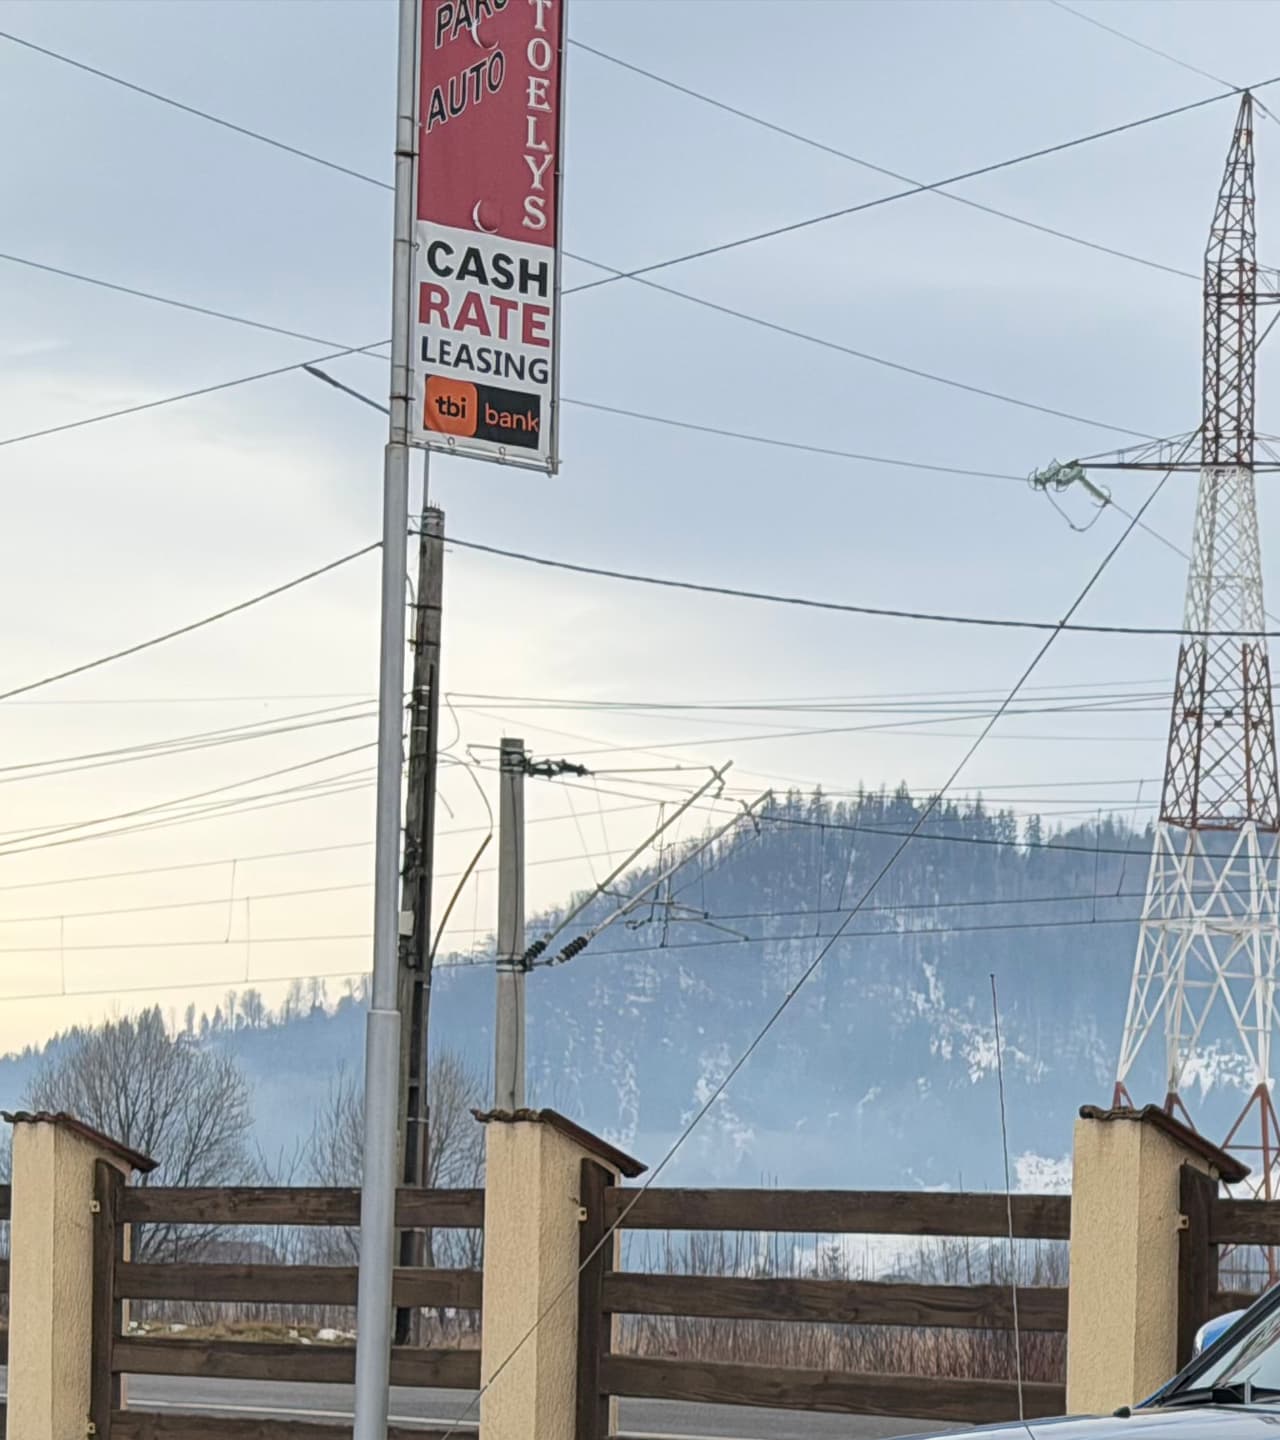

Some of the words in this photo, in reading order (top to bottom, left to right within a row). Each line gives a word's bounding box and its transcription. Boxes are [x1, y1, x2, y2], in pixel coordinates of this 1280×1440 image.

[435, 0, 509, 49] PAR
[426, 50, 505, 134] AUTO
[427, 240, 549, 297] CASH
[418, 281, 550, 347] RATE
[421, 336, 549, 384] LEASING
[435, 396, 466, 419] tbi
[485, 402, 540, 432] bank
